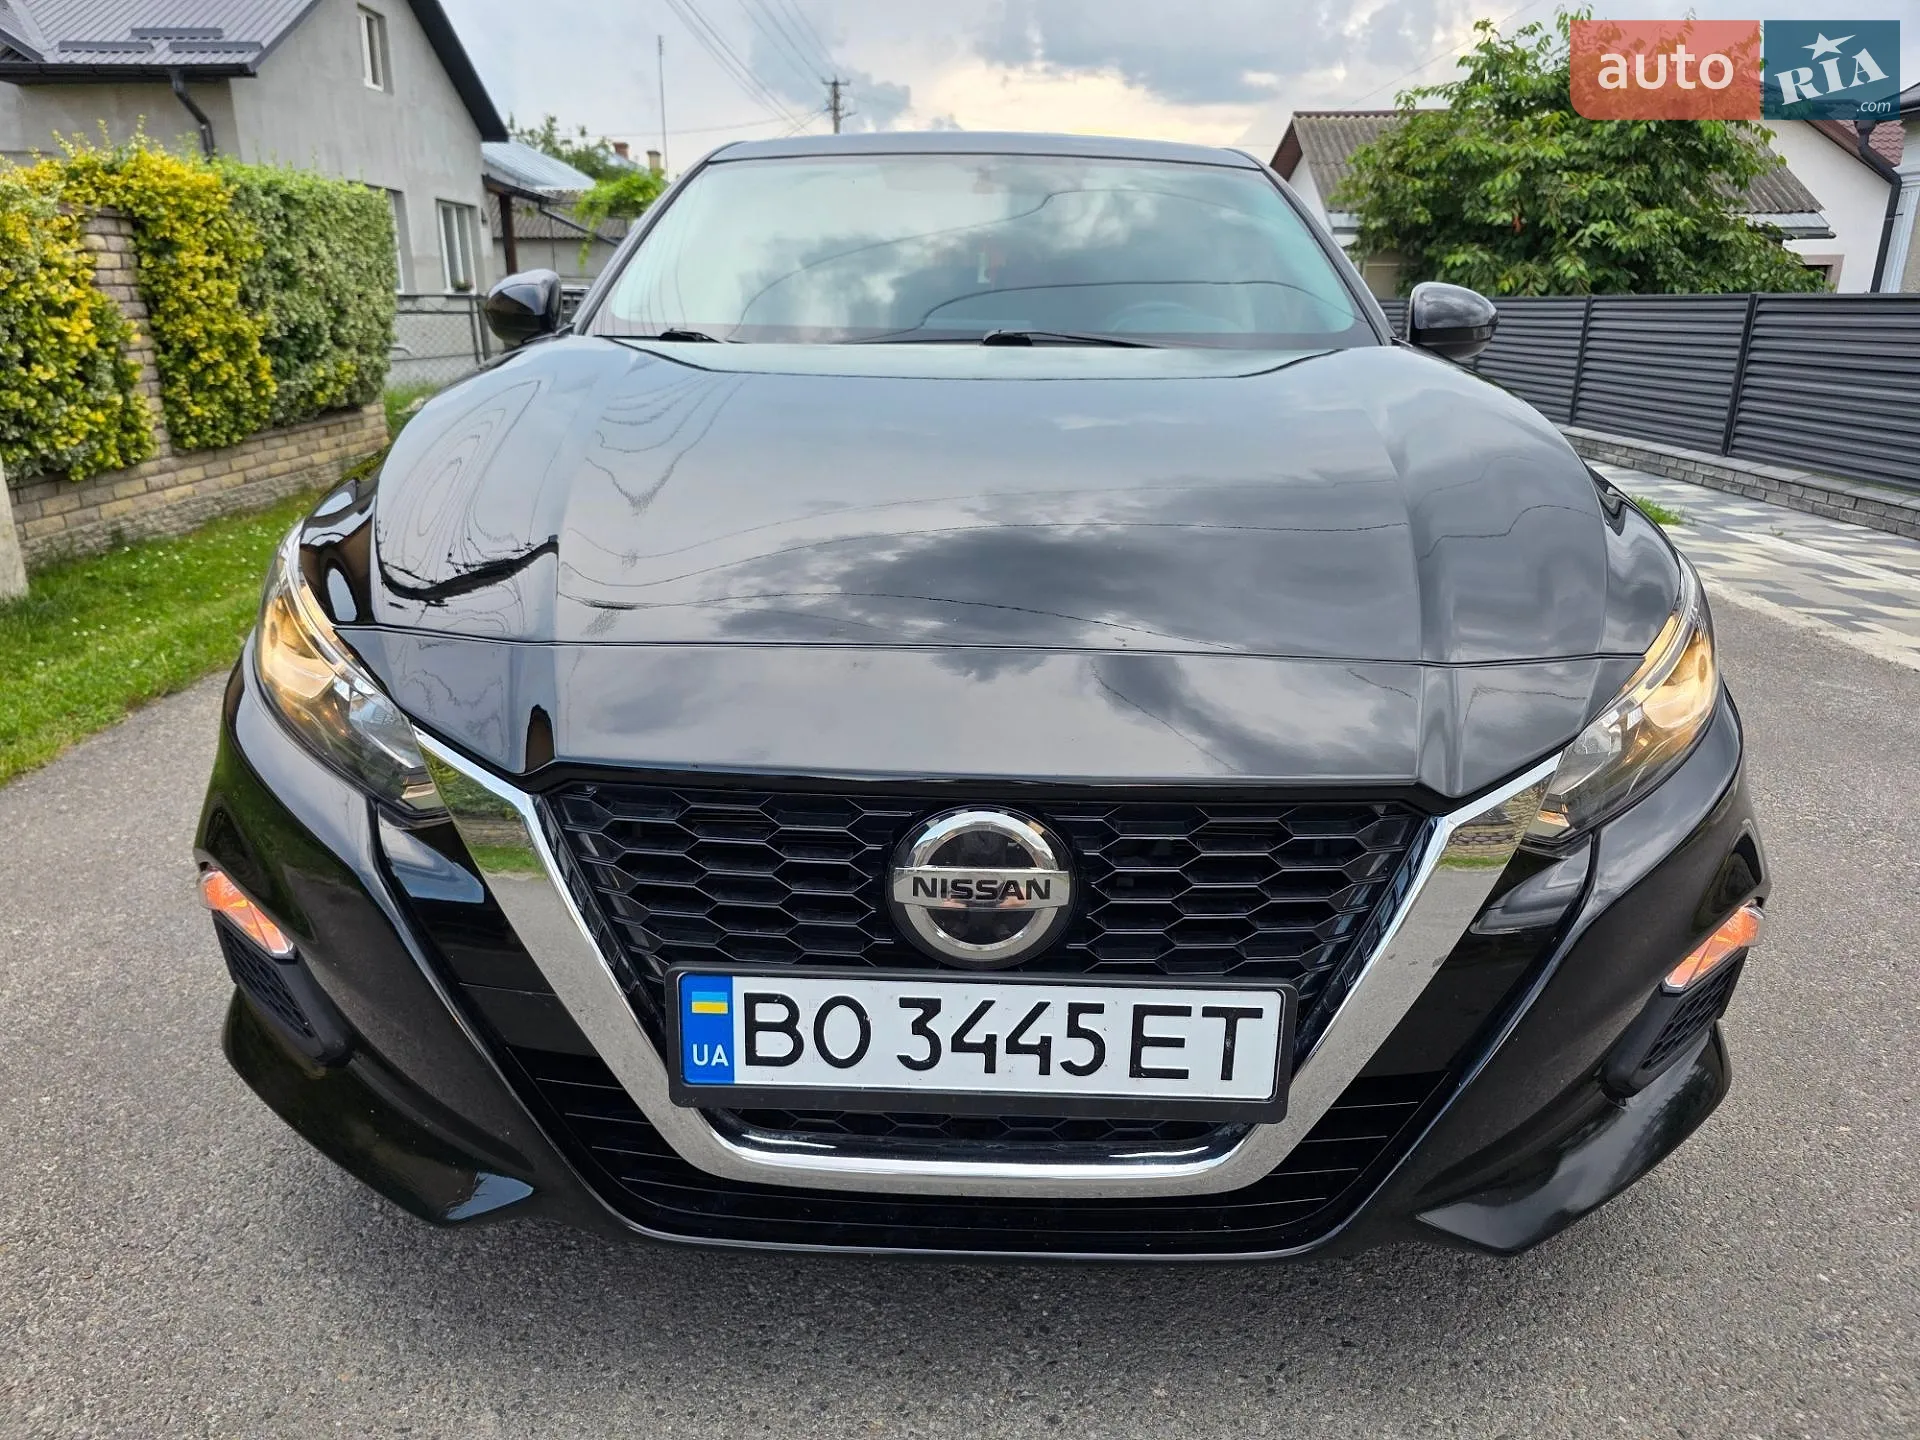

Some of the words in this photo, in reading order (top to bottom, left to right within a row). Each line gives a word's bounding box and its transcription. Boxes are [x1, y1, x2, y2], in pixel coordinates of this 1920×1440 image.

[912, 876, 1051, 901] NISSAN
[743, 992, 872, 1069] BO
[896, 996, 1106, 1076] 3445
[1129, 1004, 1264, 1081] ET
[693, 1044, 729, 1067] UA
